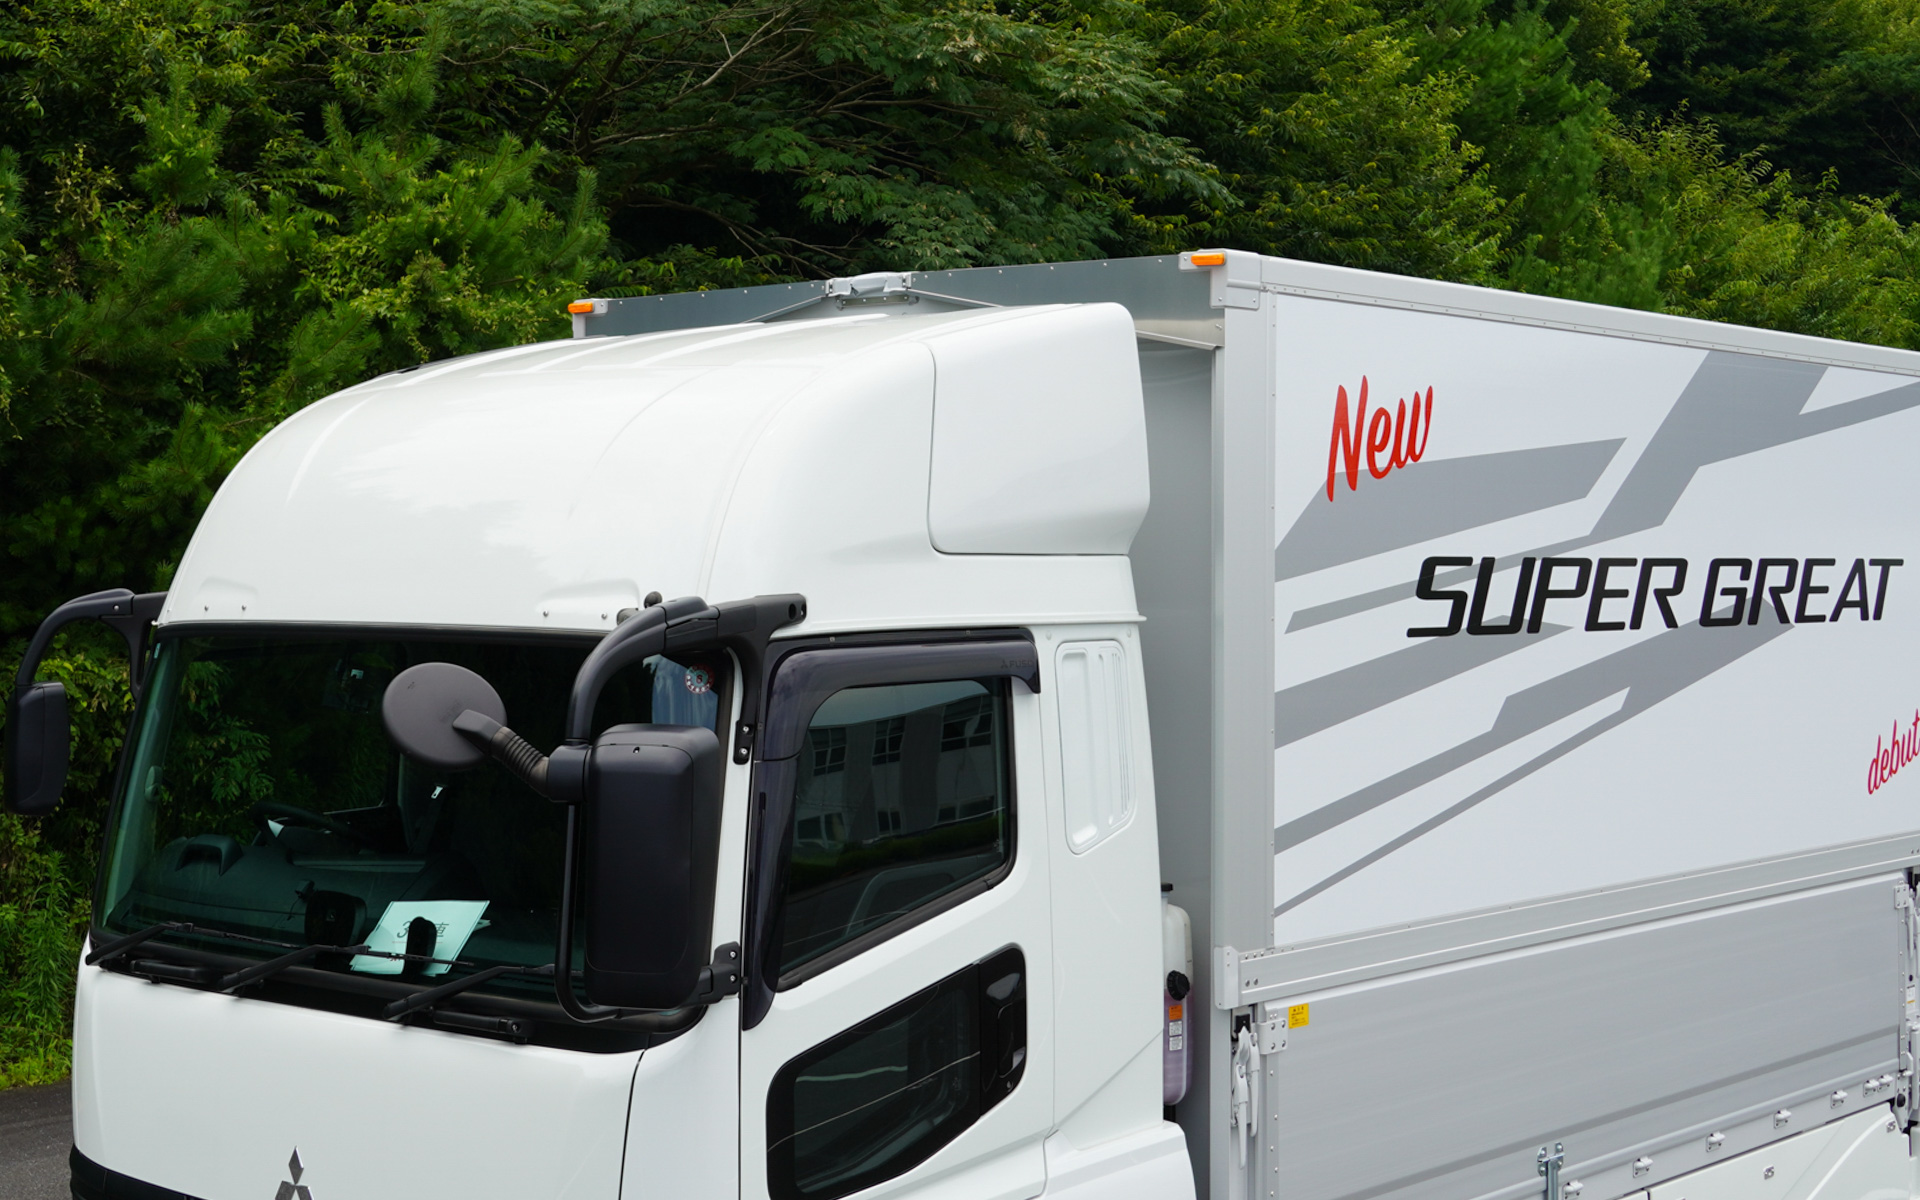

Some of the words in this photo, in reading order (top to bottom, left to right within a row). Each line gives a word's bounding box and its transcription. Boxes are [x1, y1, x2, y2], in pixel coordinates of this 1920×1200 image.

[1326, 374, 1434, 503] New
[1406, 556, 1688, 638] SUPER
[1699, 557, 1905, 628] GREAT
[1867, 707, 1920, 795] debut
[396, 920, 450, 938] 3車
